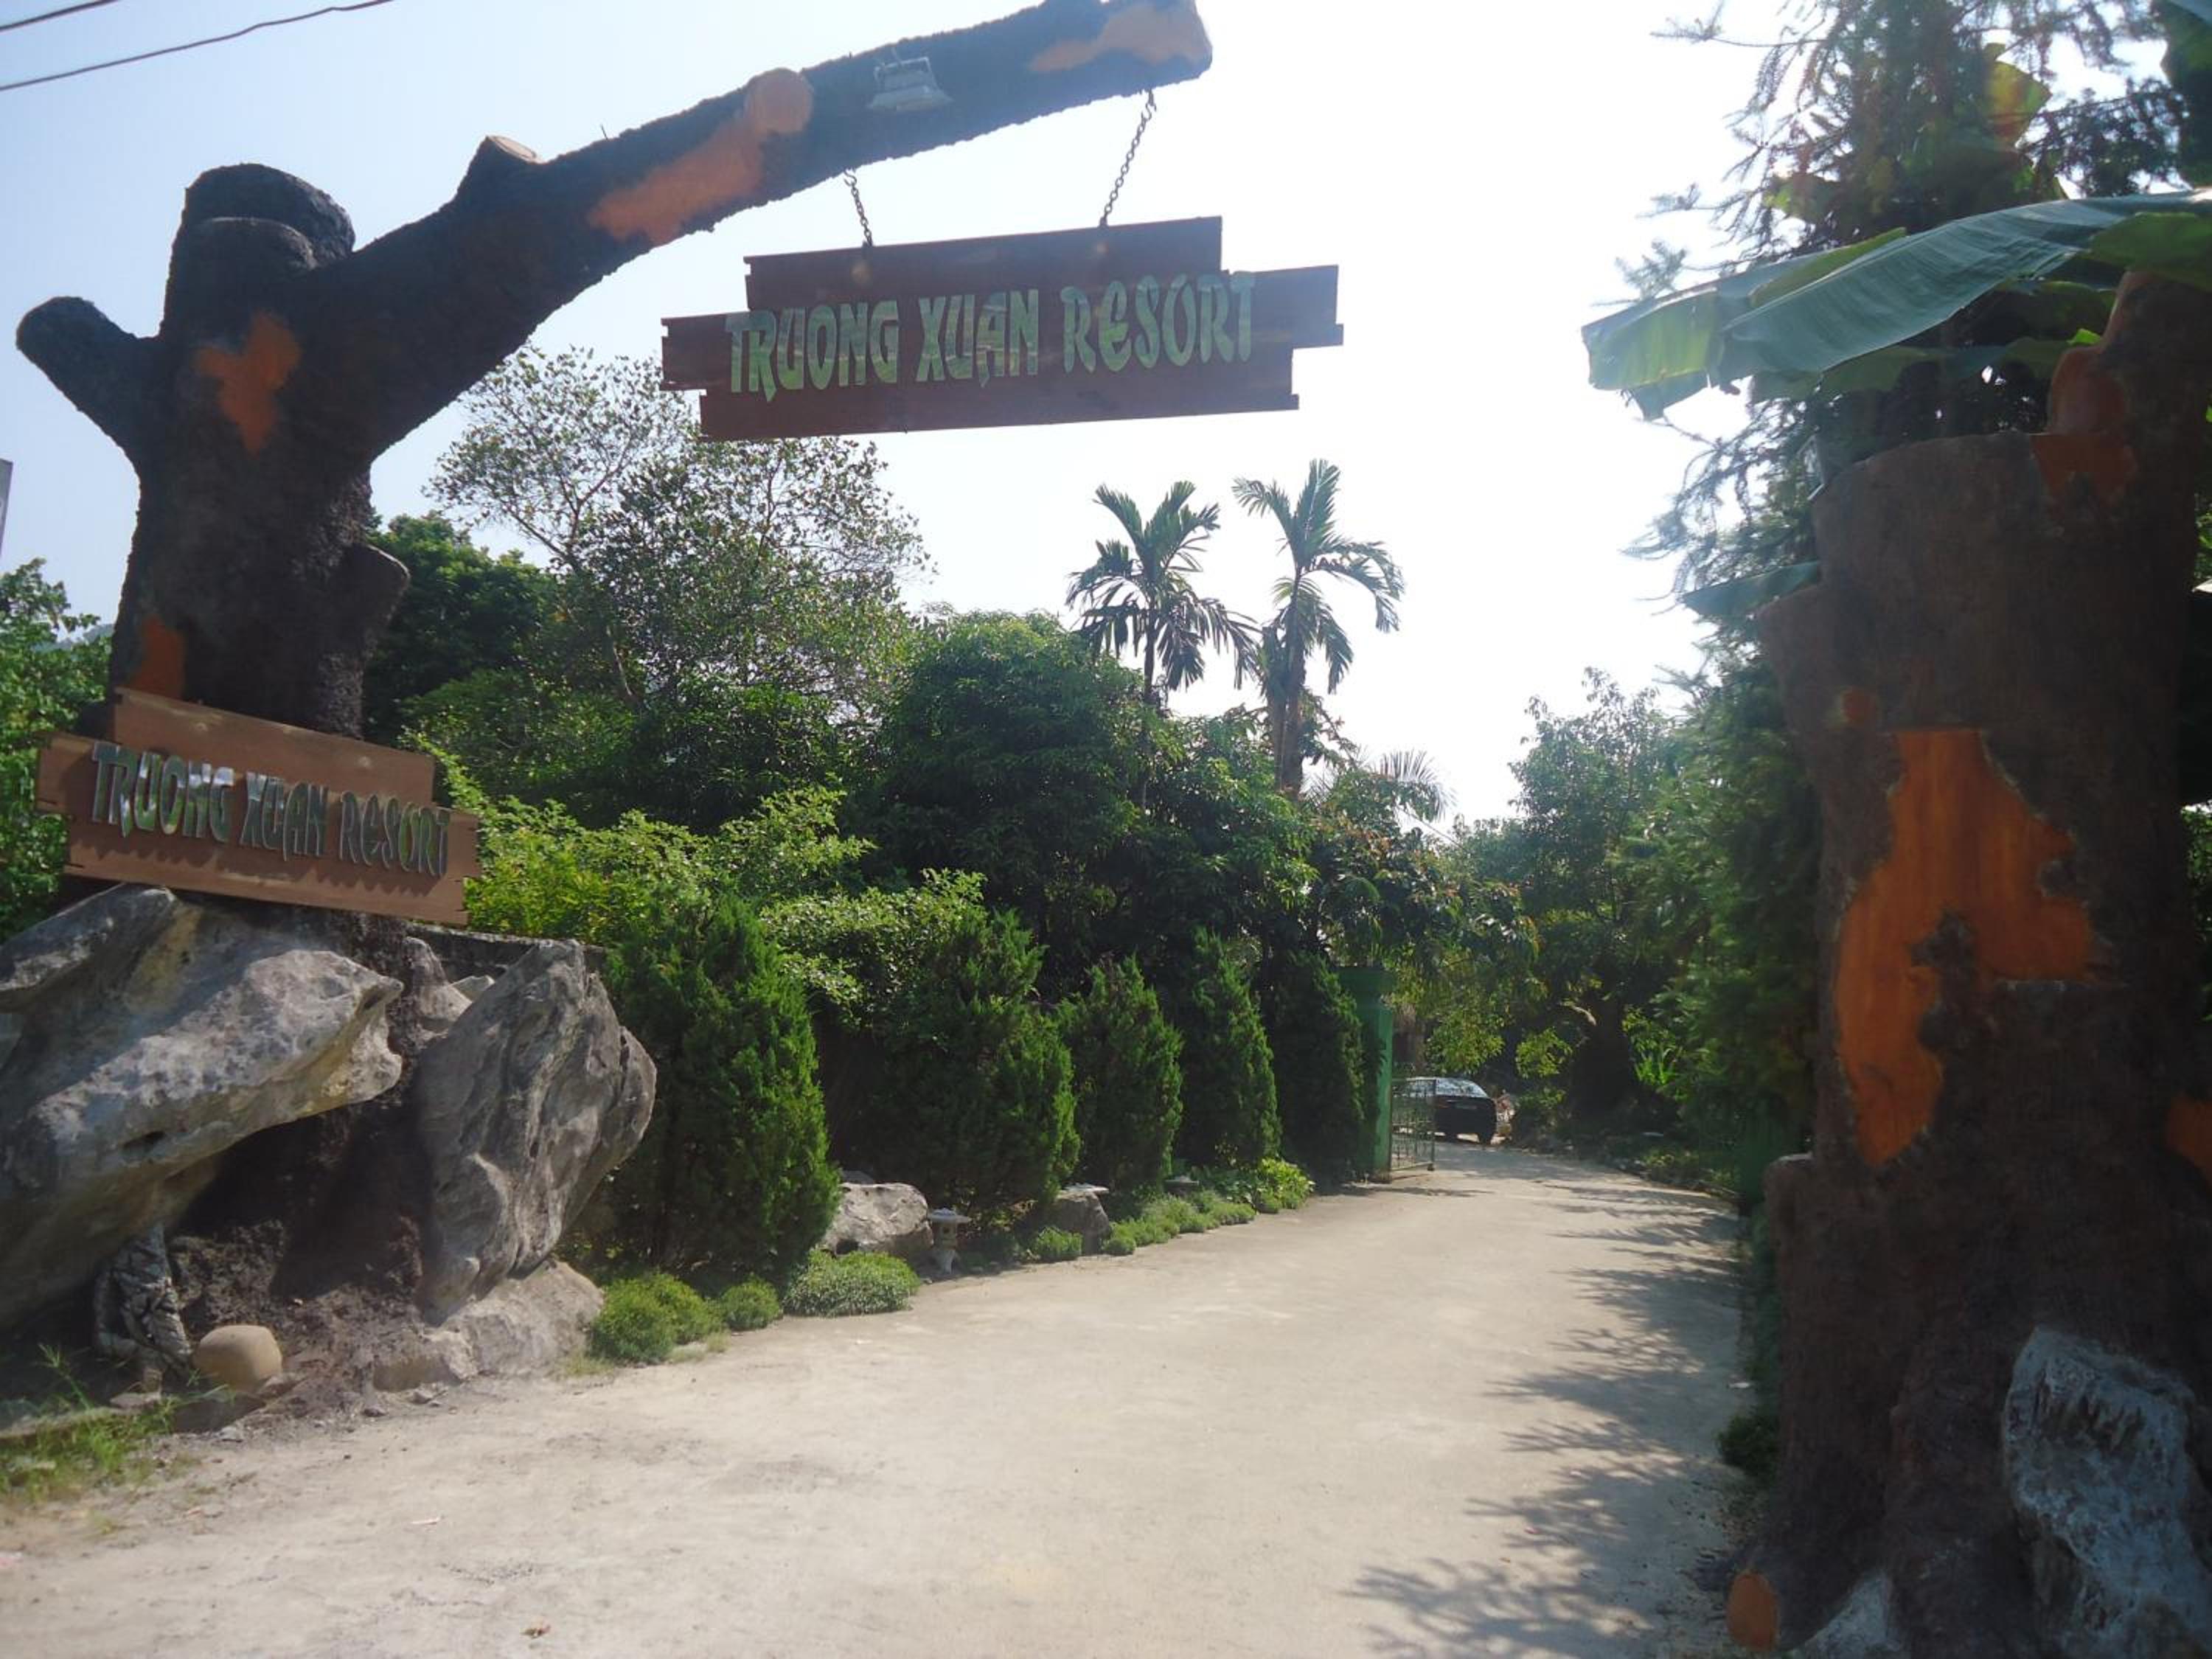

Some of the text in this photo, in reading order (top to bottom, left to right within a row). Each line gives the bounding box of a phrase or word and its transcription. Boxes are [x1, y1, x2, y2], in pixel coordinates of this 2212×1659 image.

[725, 271, 1256, 402] TRUONG XUAN RESORT
[90, 740, 450, 876] TRUONG XUAN RESORT
